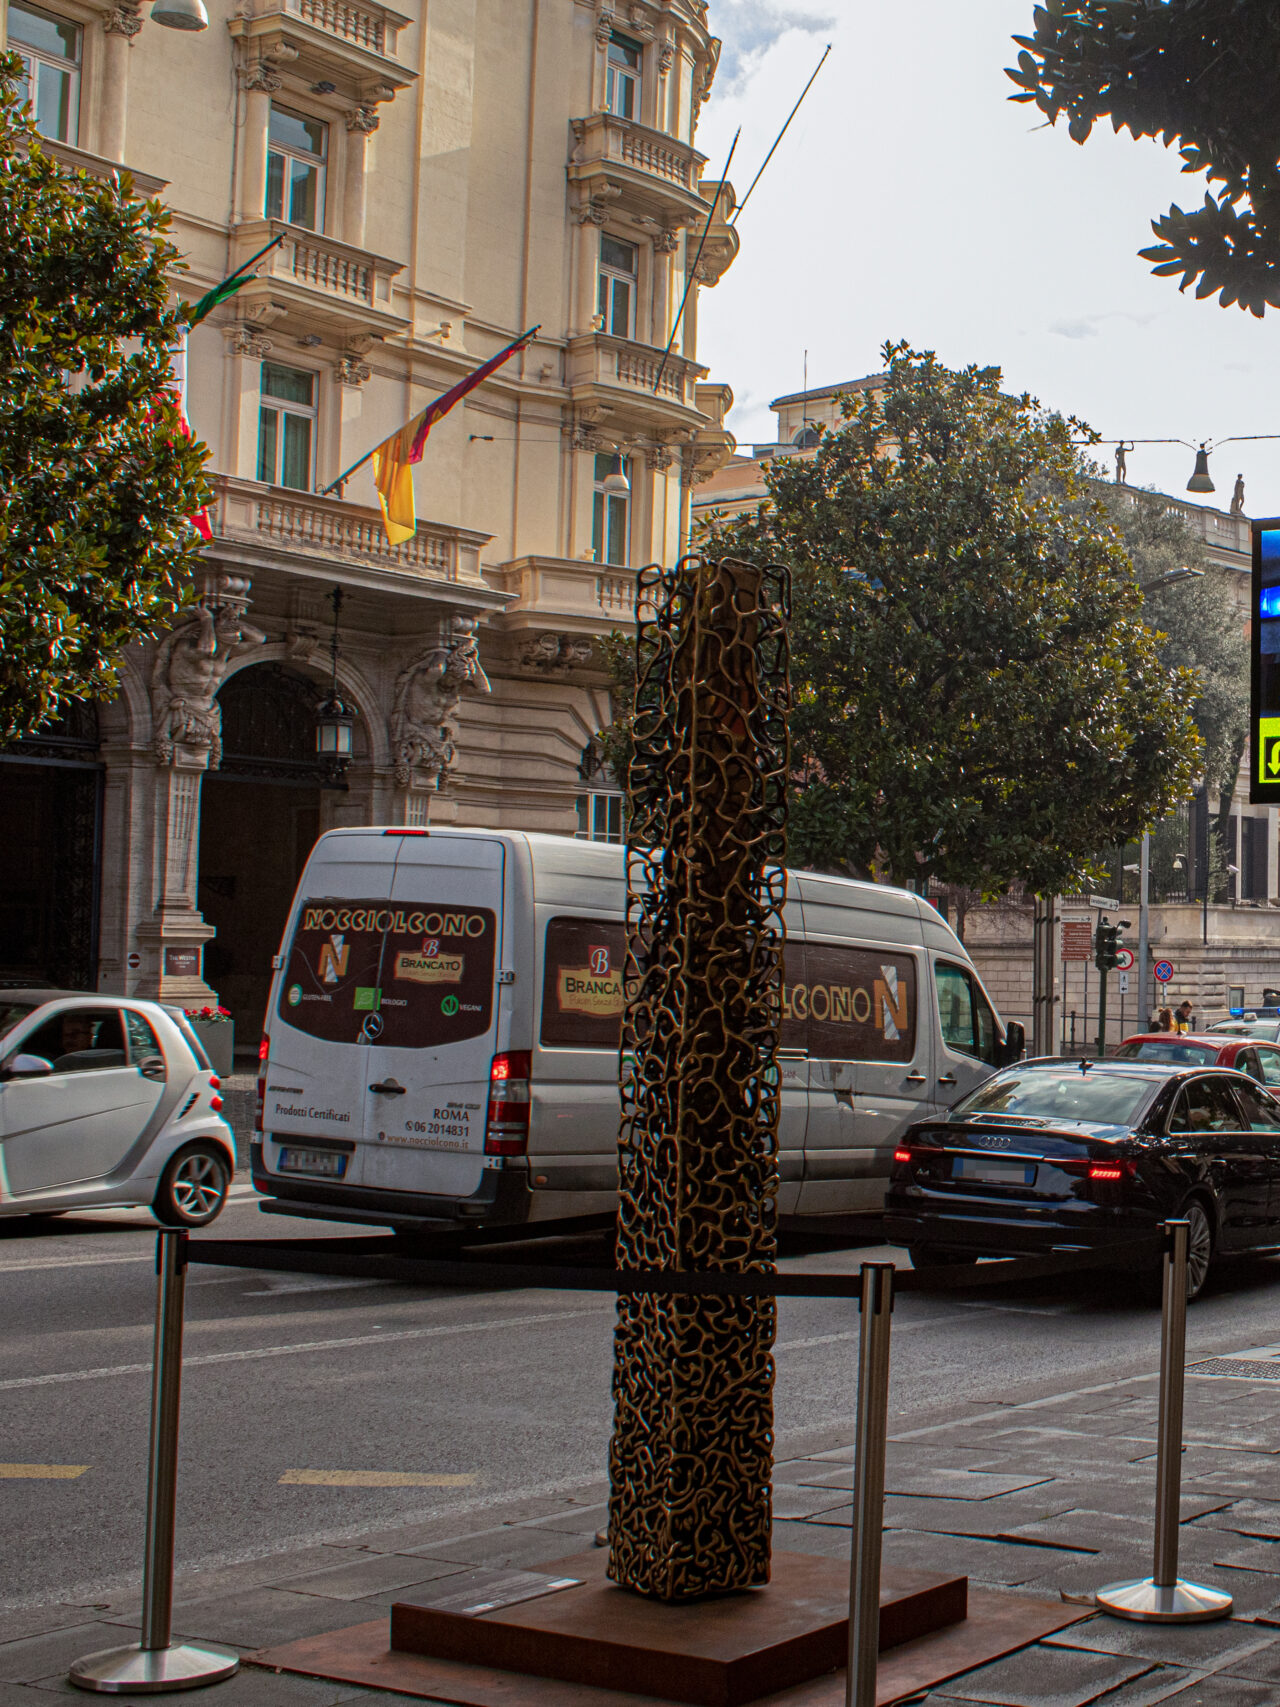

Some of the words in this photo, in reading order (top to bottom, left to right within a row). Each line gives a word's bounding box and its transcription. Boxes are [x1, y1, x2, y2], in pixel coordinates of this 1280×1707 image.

[303, 908, 486, 938] NOCCIOLCONO
[401, 957, 461, 971] BRANCATO
[565, 976, 639, 996] BRANCAO
[275, 1104, 307, 1118] Prodotti
[308, 1107, 351, 1122] Certificati
[433, 1108, 470, 1121] ROMA
[414, 1121, 426, 1133] 06
[427, 1122, 470, 1137] 2014831
[387, 1134, 469, 1149] www.nocciolcono.it
